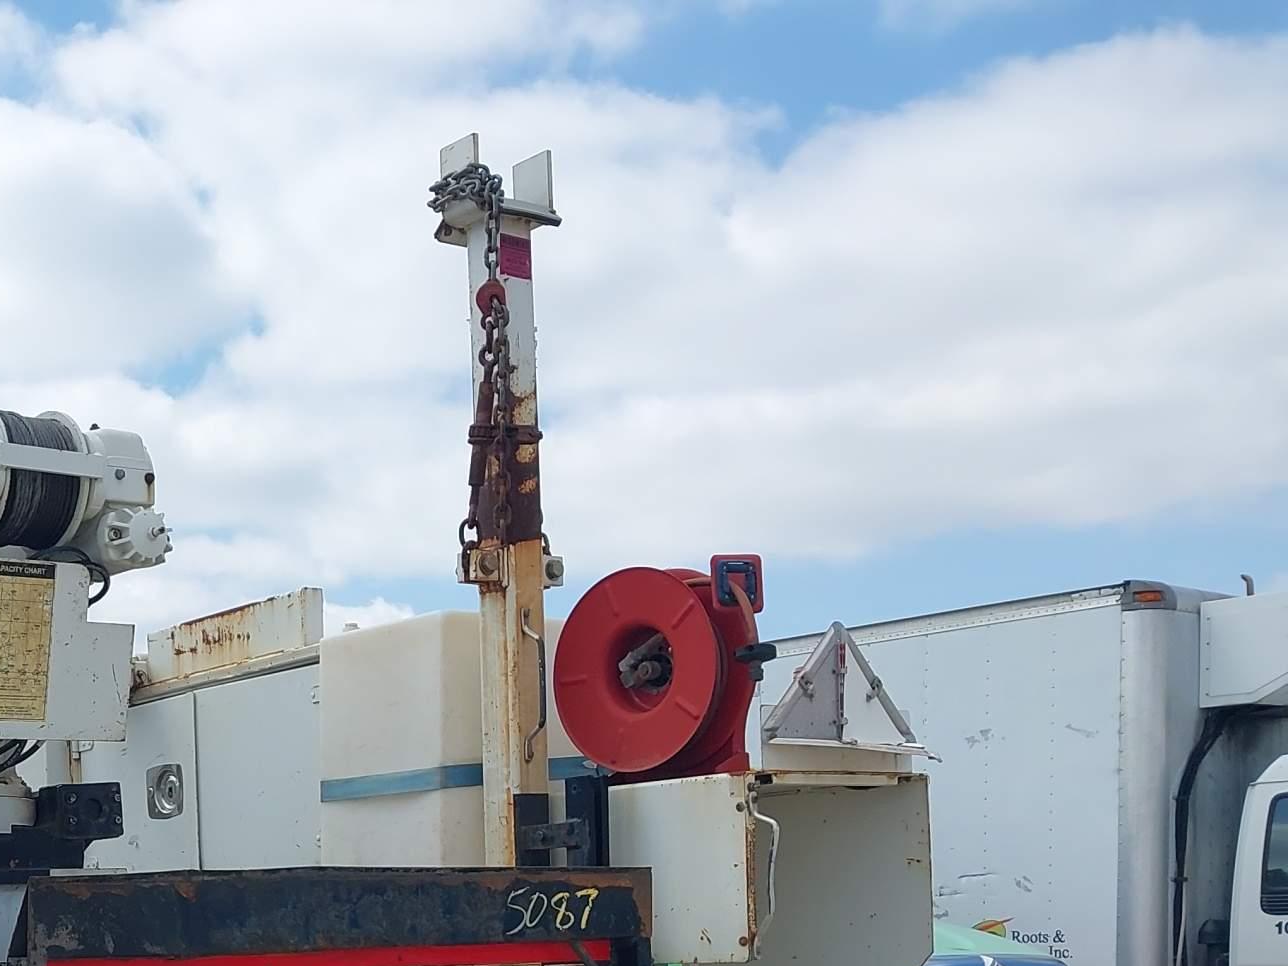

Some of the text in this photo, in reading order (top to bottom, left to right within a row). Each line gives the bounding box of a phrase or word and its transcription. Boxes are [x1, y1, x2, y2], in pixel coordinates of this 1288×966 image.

[24, 567, 48, 575] CHART
[506, 886, 599, 935] 5087
[1011, 930, 1066, 944] Roots &
[1048, 946, 1073, 959] Inc.
